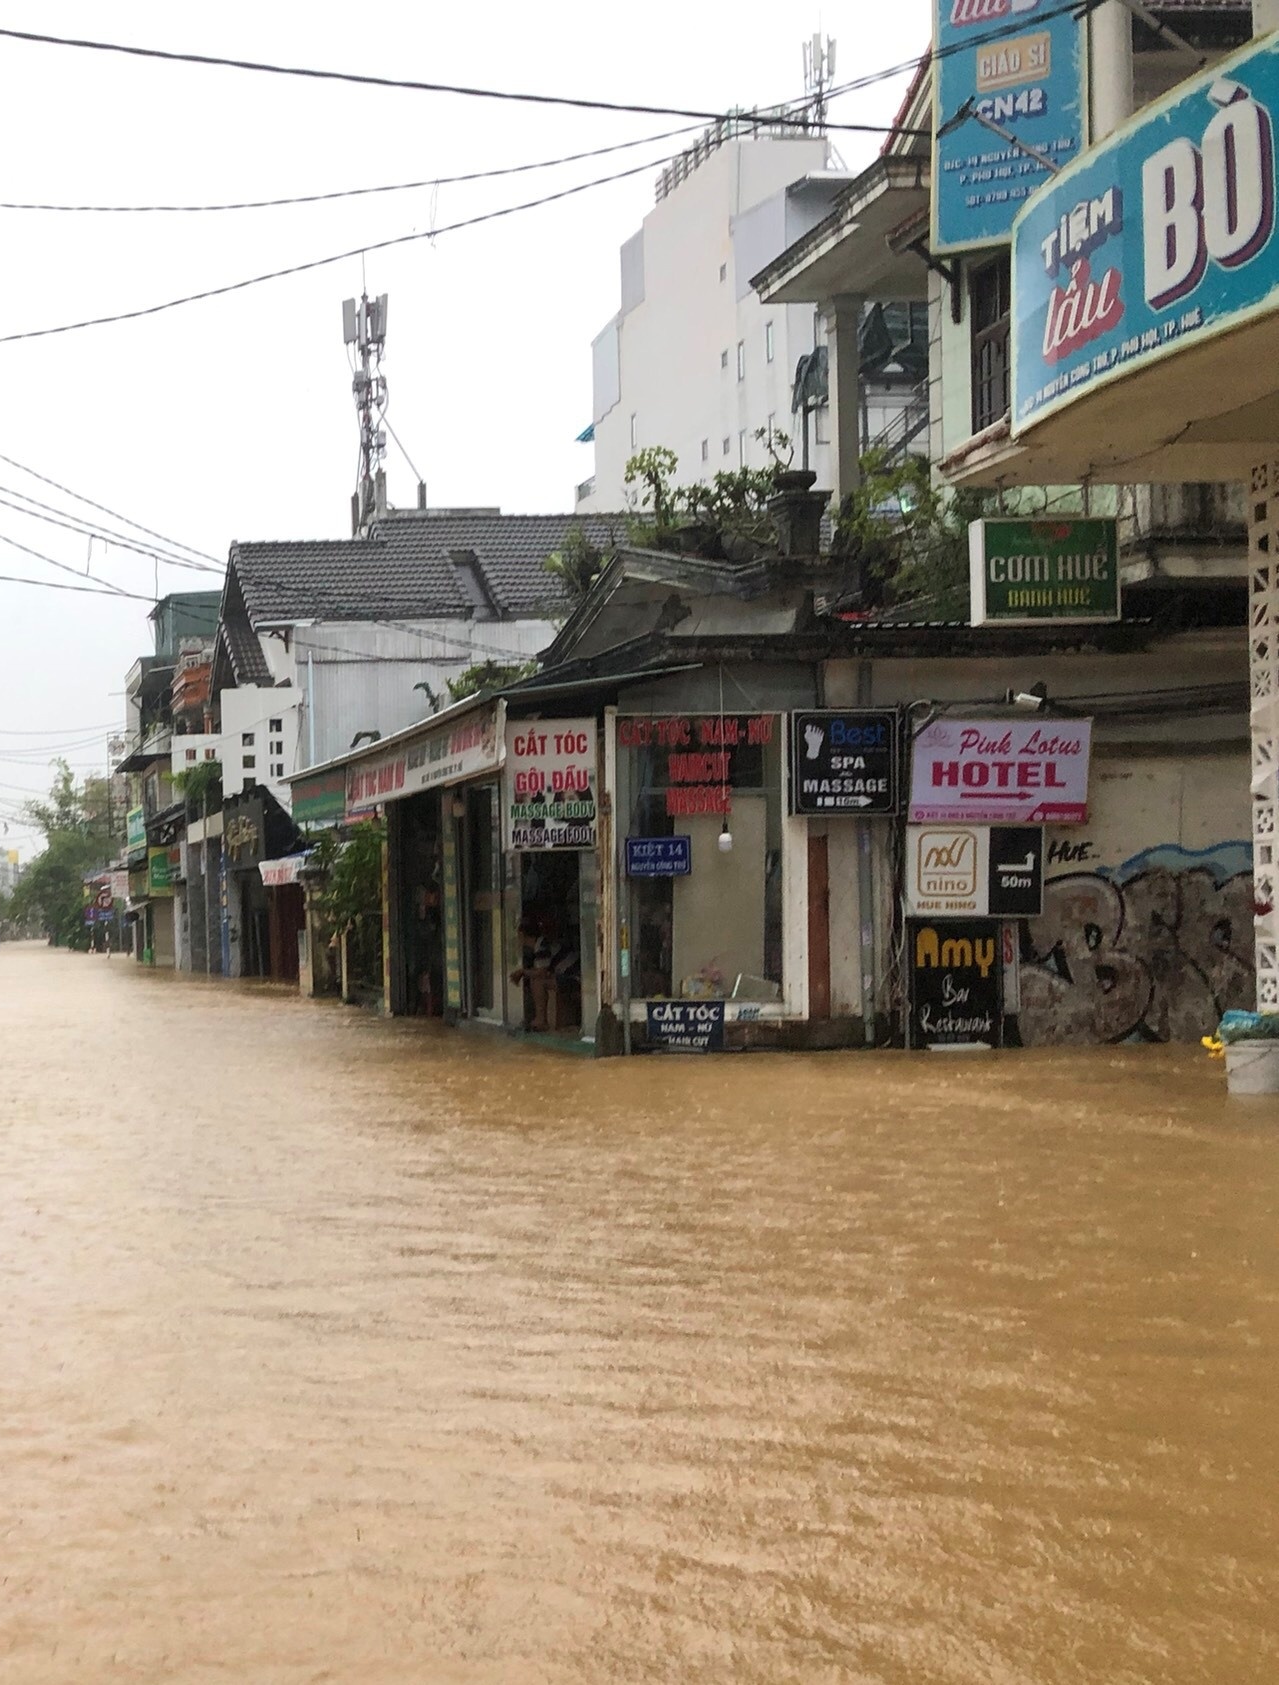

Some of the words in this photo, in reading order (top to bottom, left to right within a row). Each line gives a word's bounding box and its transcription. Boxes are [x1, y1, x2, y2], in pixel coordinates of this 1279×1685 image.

[977, 88, 1044, 119] CN42
[1142, 79, 1270, 308] BÒ
[1041, 188, 1115, 272] TIỆM
[1043, 261, 1117, 356] lẩu
[514, 728, 547, 756] CẮT
[554, 730, 587, 755] TÓC
[830, 719, 885, 745] Best
[959, 728, 1012, 755] Pink
[1018, 729, 1082, 755] Lotus
[669, 752, 731, 782] HAIRCUT
[830, 756, 866, 770] SPA
[931, 761, 1067, 788] HOTEL
[516, 767, 545, 795] GỘI
[803, 779, 888, 793] MASSAGE
[511, 804, 561, 819] MASSAGE
[565, 801, 594, 817] BODY
[666, 785, 732, 815] MASSAGE
[512, 828, 563, 844] MASSAGE
[565, 825, 593, 842] FOOT
[669, 843, 683, 856] 14
[926, 876, 968, 892] nino
[1000, 875, 1032, 889] 50m
[916, 927, 995, 978] Amy
[941, 973, 970, 1007] Bar
[686, 1004, 720, 1021] TÓC
[660, 1023, 685, 1033] NAM
